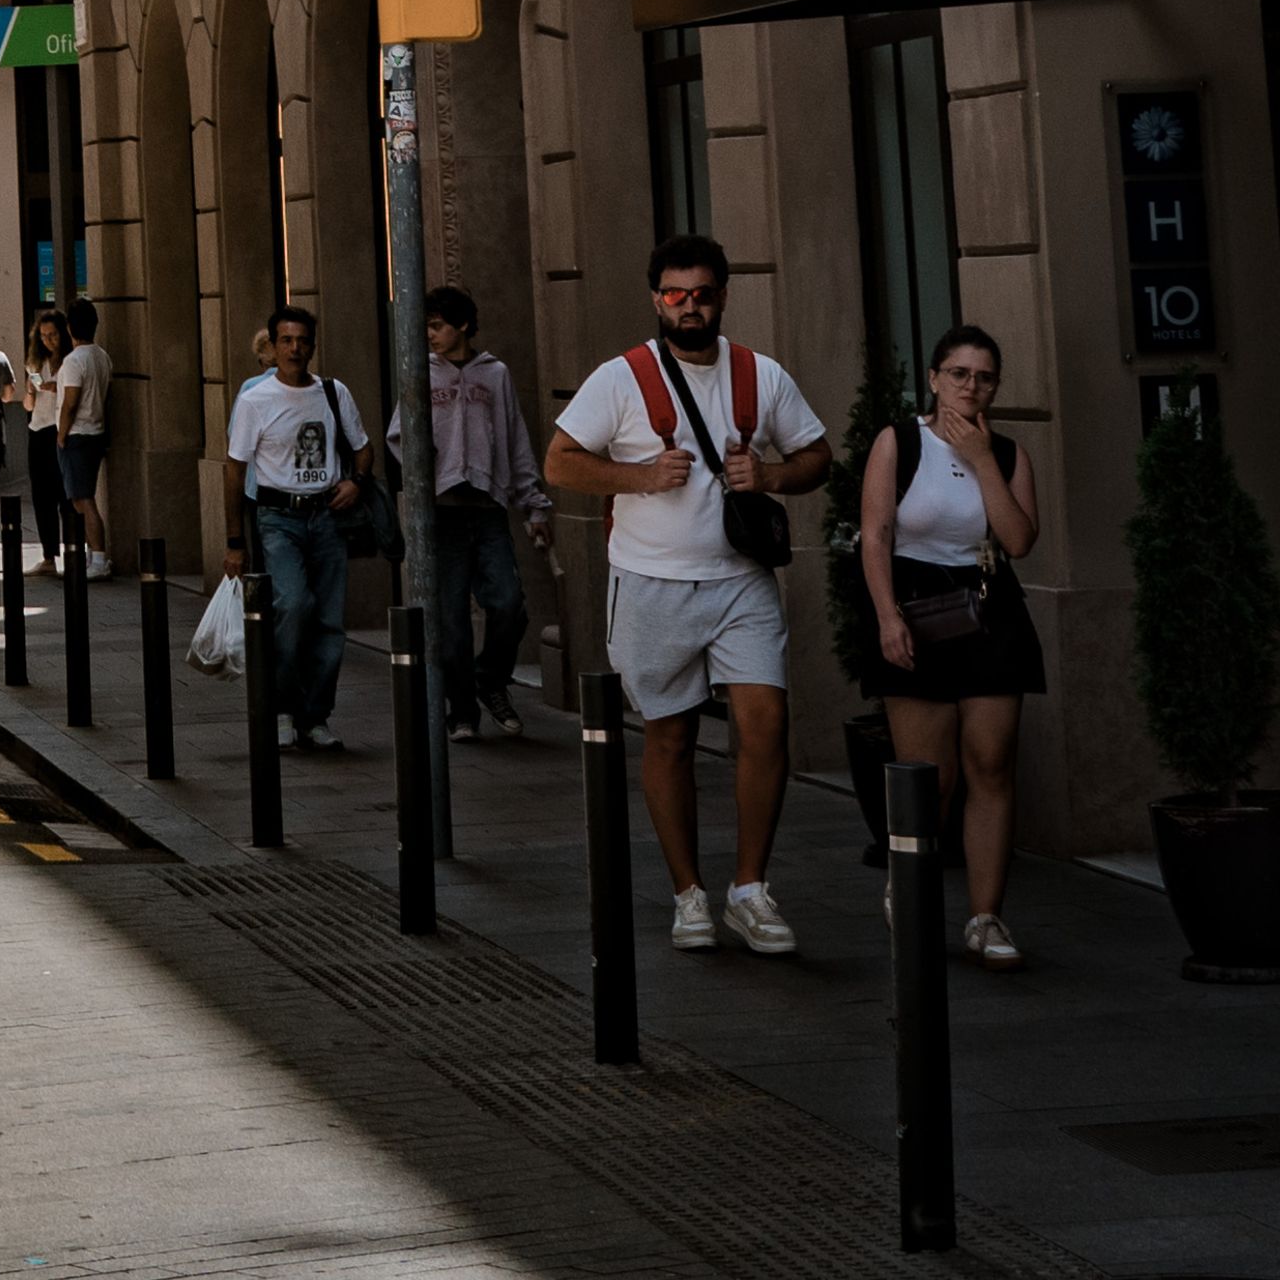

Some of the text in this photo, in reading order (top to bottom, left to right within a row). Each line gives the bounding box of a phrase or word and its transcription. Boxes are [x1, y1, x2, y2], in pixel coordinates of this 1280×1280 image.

[1147, 200, 1184, 241] H
[1144, 285, 1200, 327] 10
[1152, 329, 1201, 340] HOTELS
[294, 470, 328, 482] 1990
